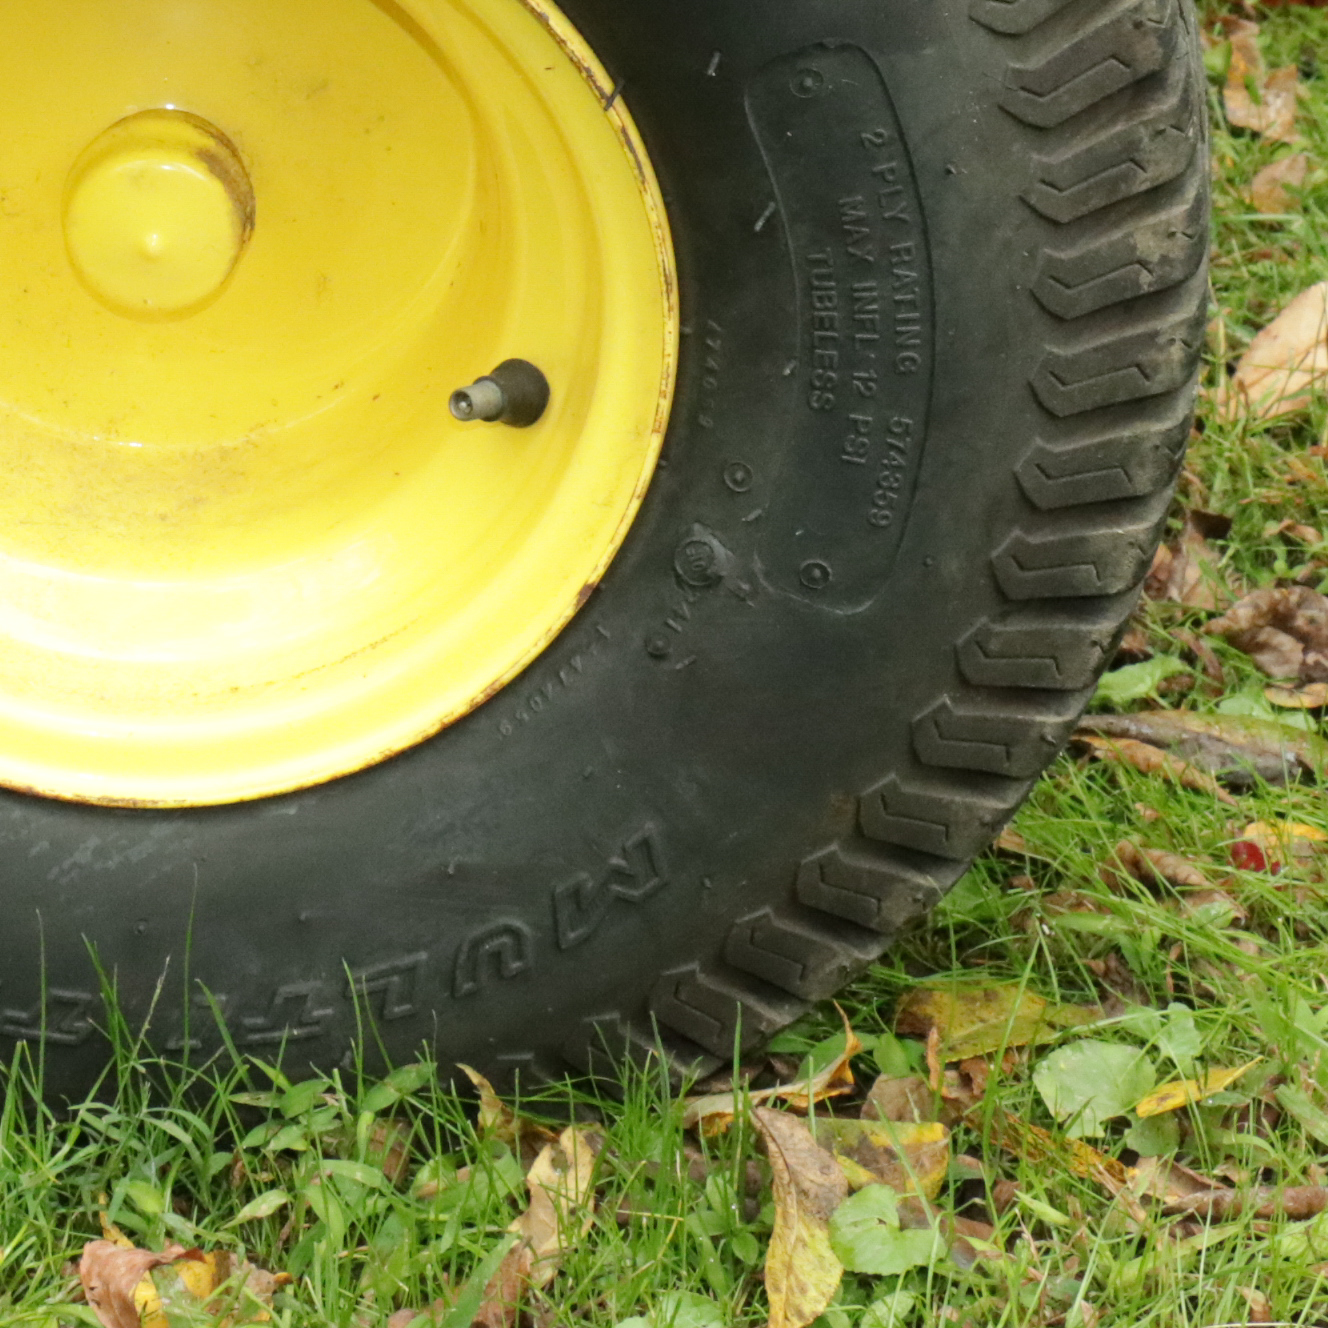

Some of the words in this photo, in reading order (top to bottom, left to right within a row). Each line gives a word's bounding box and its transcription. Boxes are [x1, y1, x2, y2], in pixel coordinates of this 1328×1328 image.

[861, 128, 887, 149] 2
[872, 161, 911, 223] PLY
[807, 247, 839, 410] TUBELESS
[889, 241, 922, 372] RATING
[853, 369, 878, 397] 12
[841, 413, 873, 465] PSI
